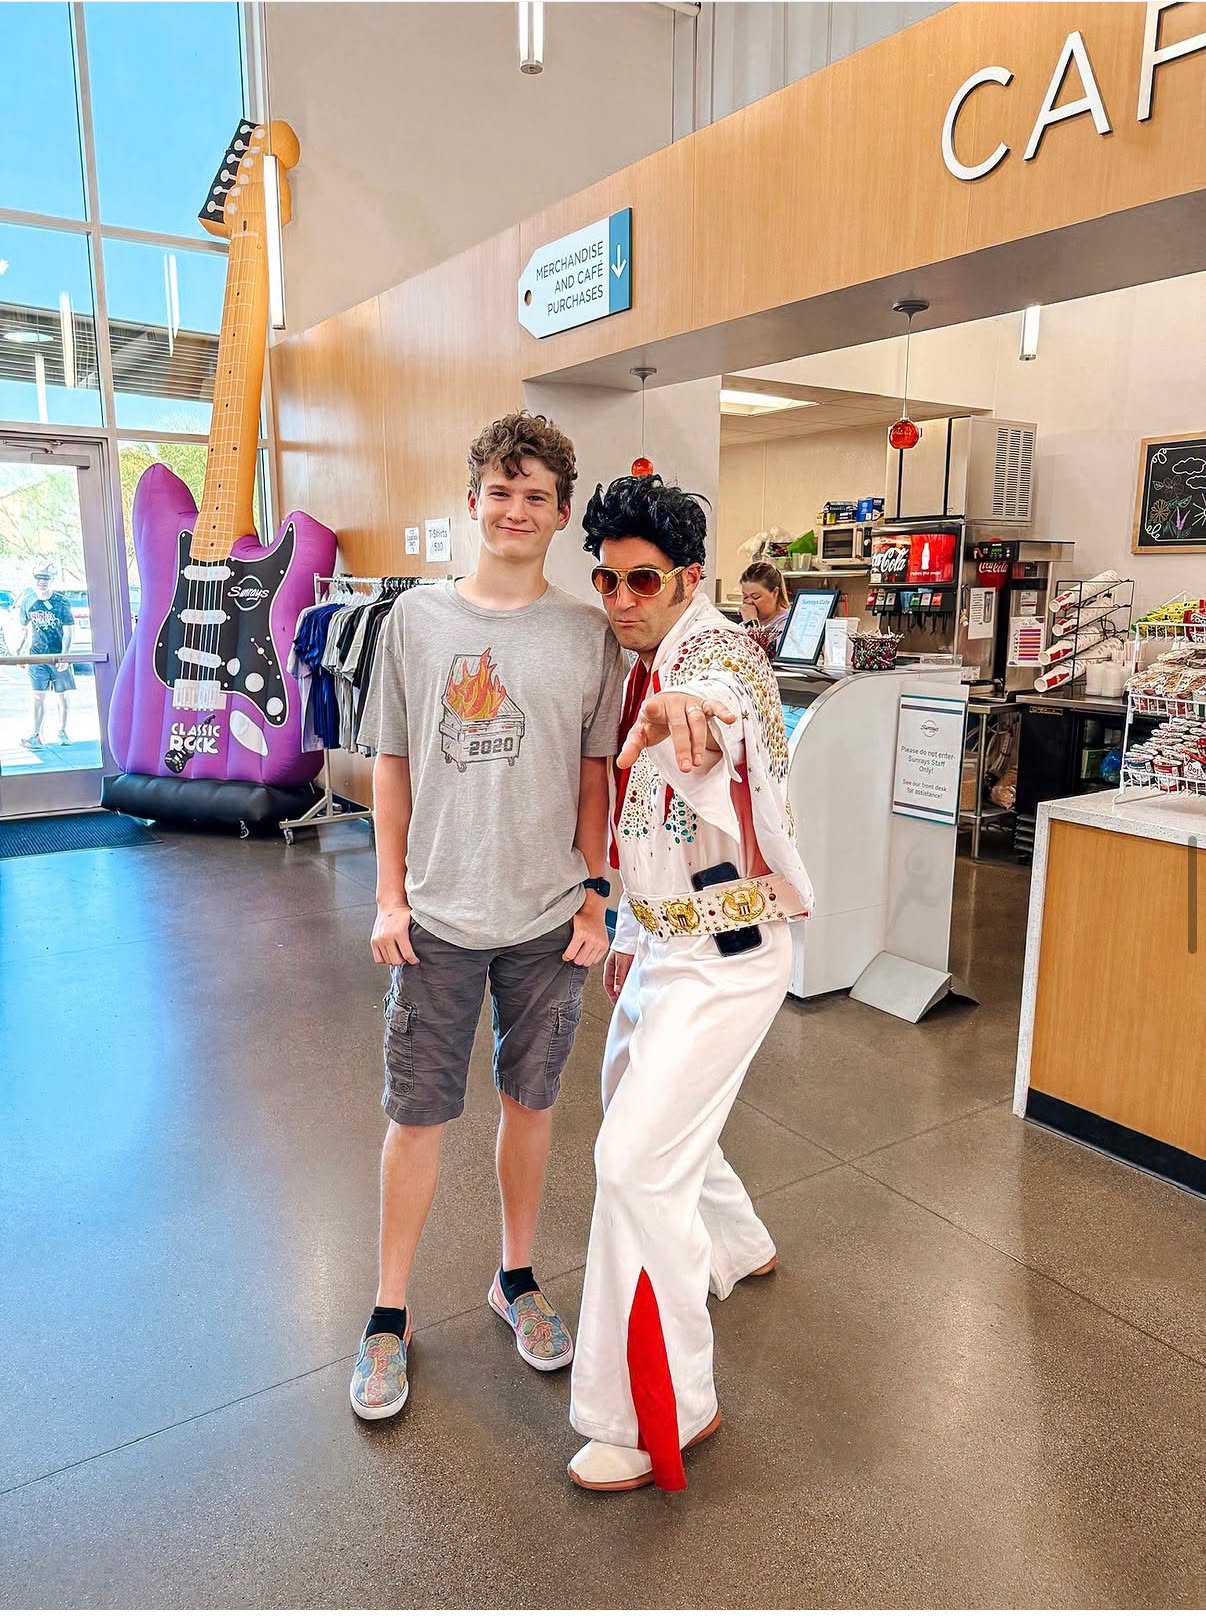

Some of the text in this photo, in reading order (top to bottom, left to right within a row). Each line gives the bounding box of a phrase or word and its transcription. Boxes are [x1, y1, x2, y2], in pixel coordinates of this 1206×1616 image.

[536, 240, 604, 281] MERCHANDISE
[554, 259, 604, 294] AND CAFÉ
[547, 284, 604, 316] PURCHASES
[428, 529, 448, 539] T-Shirts
[171, 722, 221, 738] CLASSIC
[170, 734, 219, 754] ROCK
[469, 737, 514, 756] 2020
[901, 745, 919, 755] Please
[919, 766, 934, 775] Only!
[931, 759, 946, 767] Staff
[922, 782, 934, 790] front
